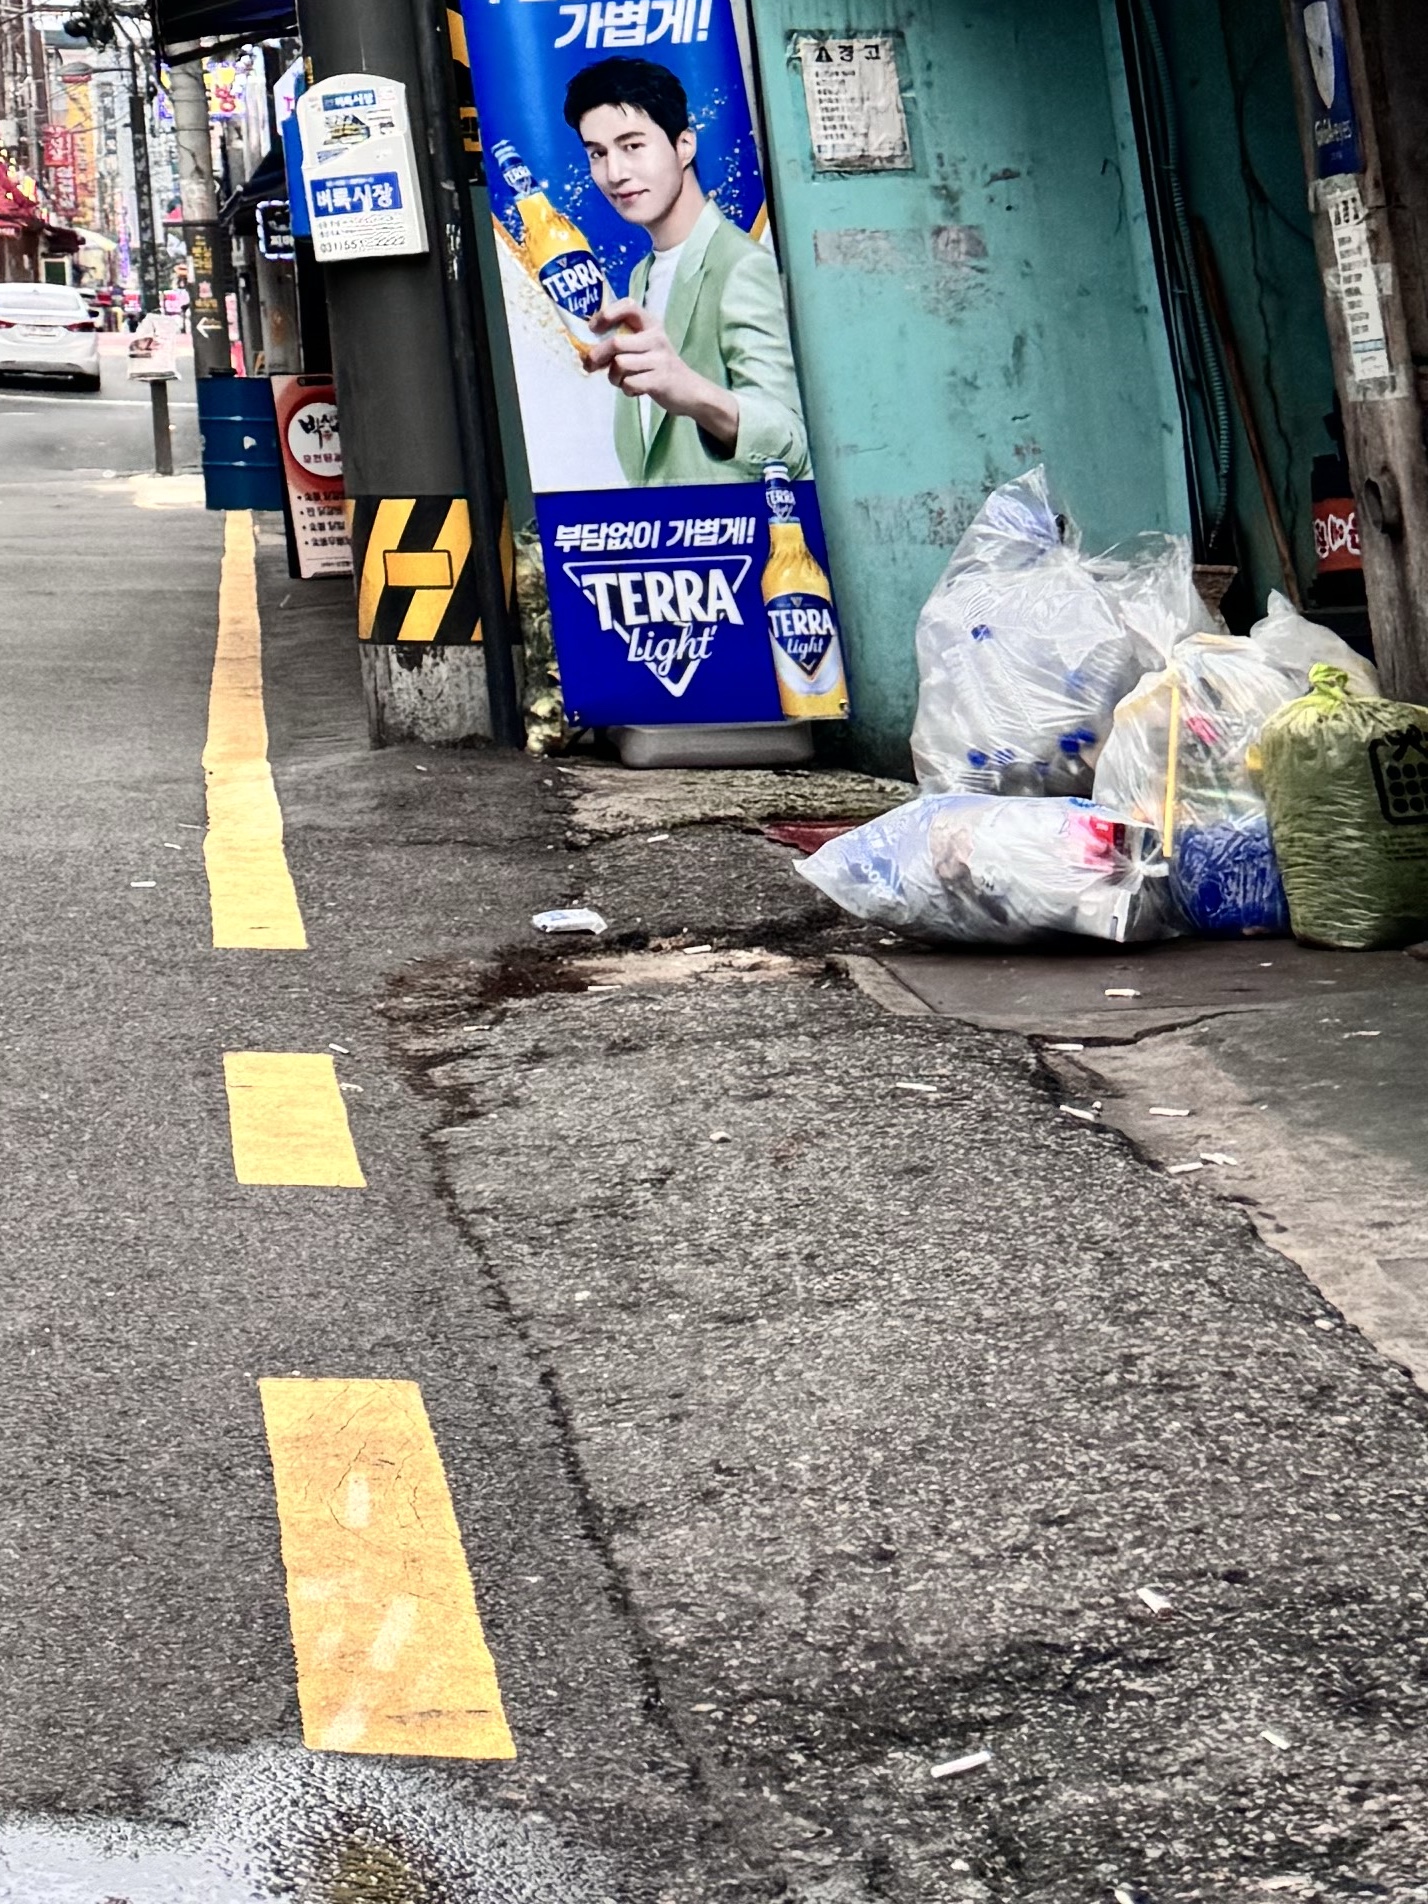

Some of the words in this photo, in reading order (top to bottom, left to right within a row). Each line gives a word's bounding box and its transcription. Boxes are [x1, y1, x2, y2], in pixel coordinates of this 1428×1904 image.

[315, 181, 394, 213] 벼룩시장
[541, 258, 605, 303] TERRA
[553, 520, 664, 554] 부담없이
[668, 515, 756, 549] 가볍게!
[583, 568, 745, 629] TERRA
[767, 608, 835, 640] TERRA
